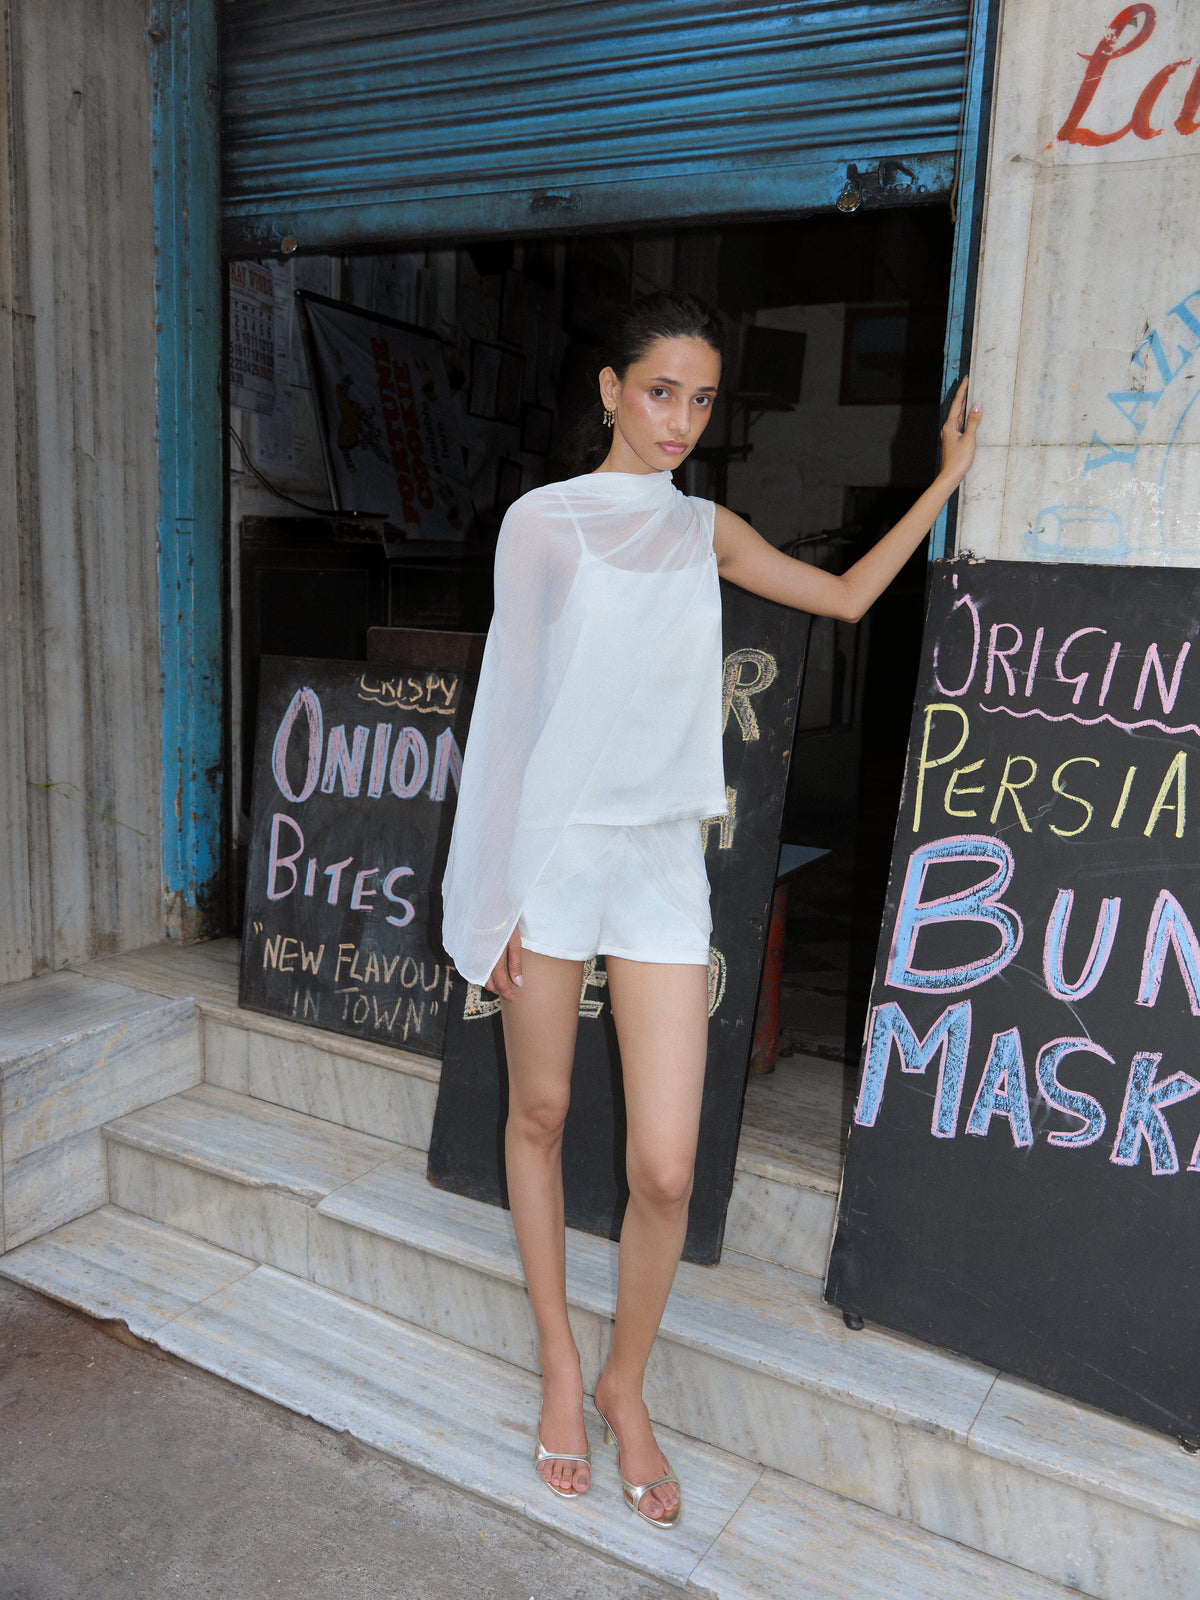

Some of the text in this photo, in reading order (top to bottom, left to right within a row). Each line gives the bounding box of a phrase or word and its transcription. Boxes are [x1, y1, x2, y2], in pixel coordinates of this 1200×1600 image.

[371, 337, 420, 526] FORTUNE
[393, 361, 434, 510] COOKIE
[913, 702, 1187, 838] PERSIA
[266, 813, 415, 927] BITES
[292, 986, 319, 1022] IN
[854, 1000, 1200, 1176] MASK
